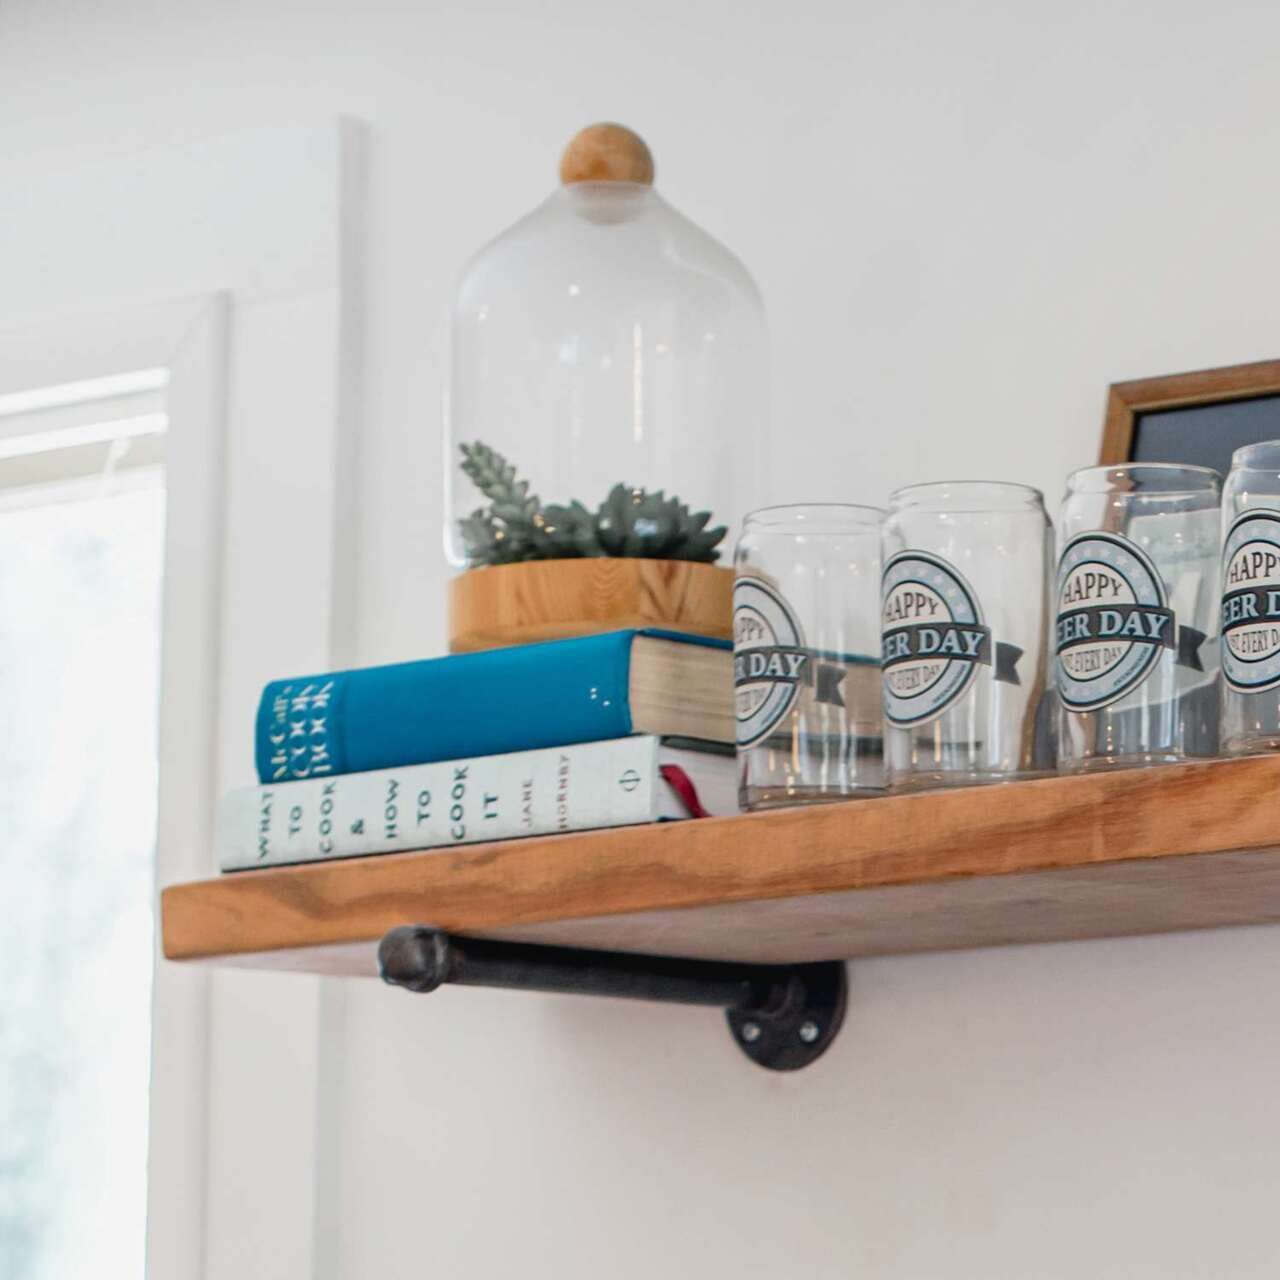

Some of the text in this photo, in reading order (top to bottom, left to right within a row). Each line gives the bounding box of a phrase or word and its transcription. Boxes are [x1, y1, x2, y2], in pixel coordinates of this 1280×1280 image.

[918, 628, 984, 655] DAY
[1099, 610, 1169, 640] DAY
[750, 653, 807, 677] DAY
[385, 779, 400, 839] HOW
[417, 790, 432, 826] TO
[451, 766, 470, 840] COOK
[483, 792, 498, 820] IT
[522, 779, 534, 827] JANE
[557, 754, 571, 830] HORNBY
[258, 792, 274, 860] WHAT
[289, 806, 303, 836] TO
[319, 782, 337, 854] COOK
